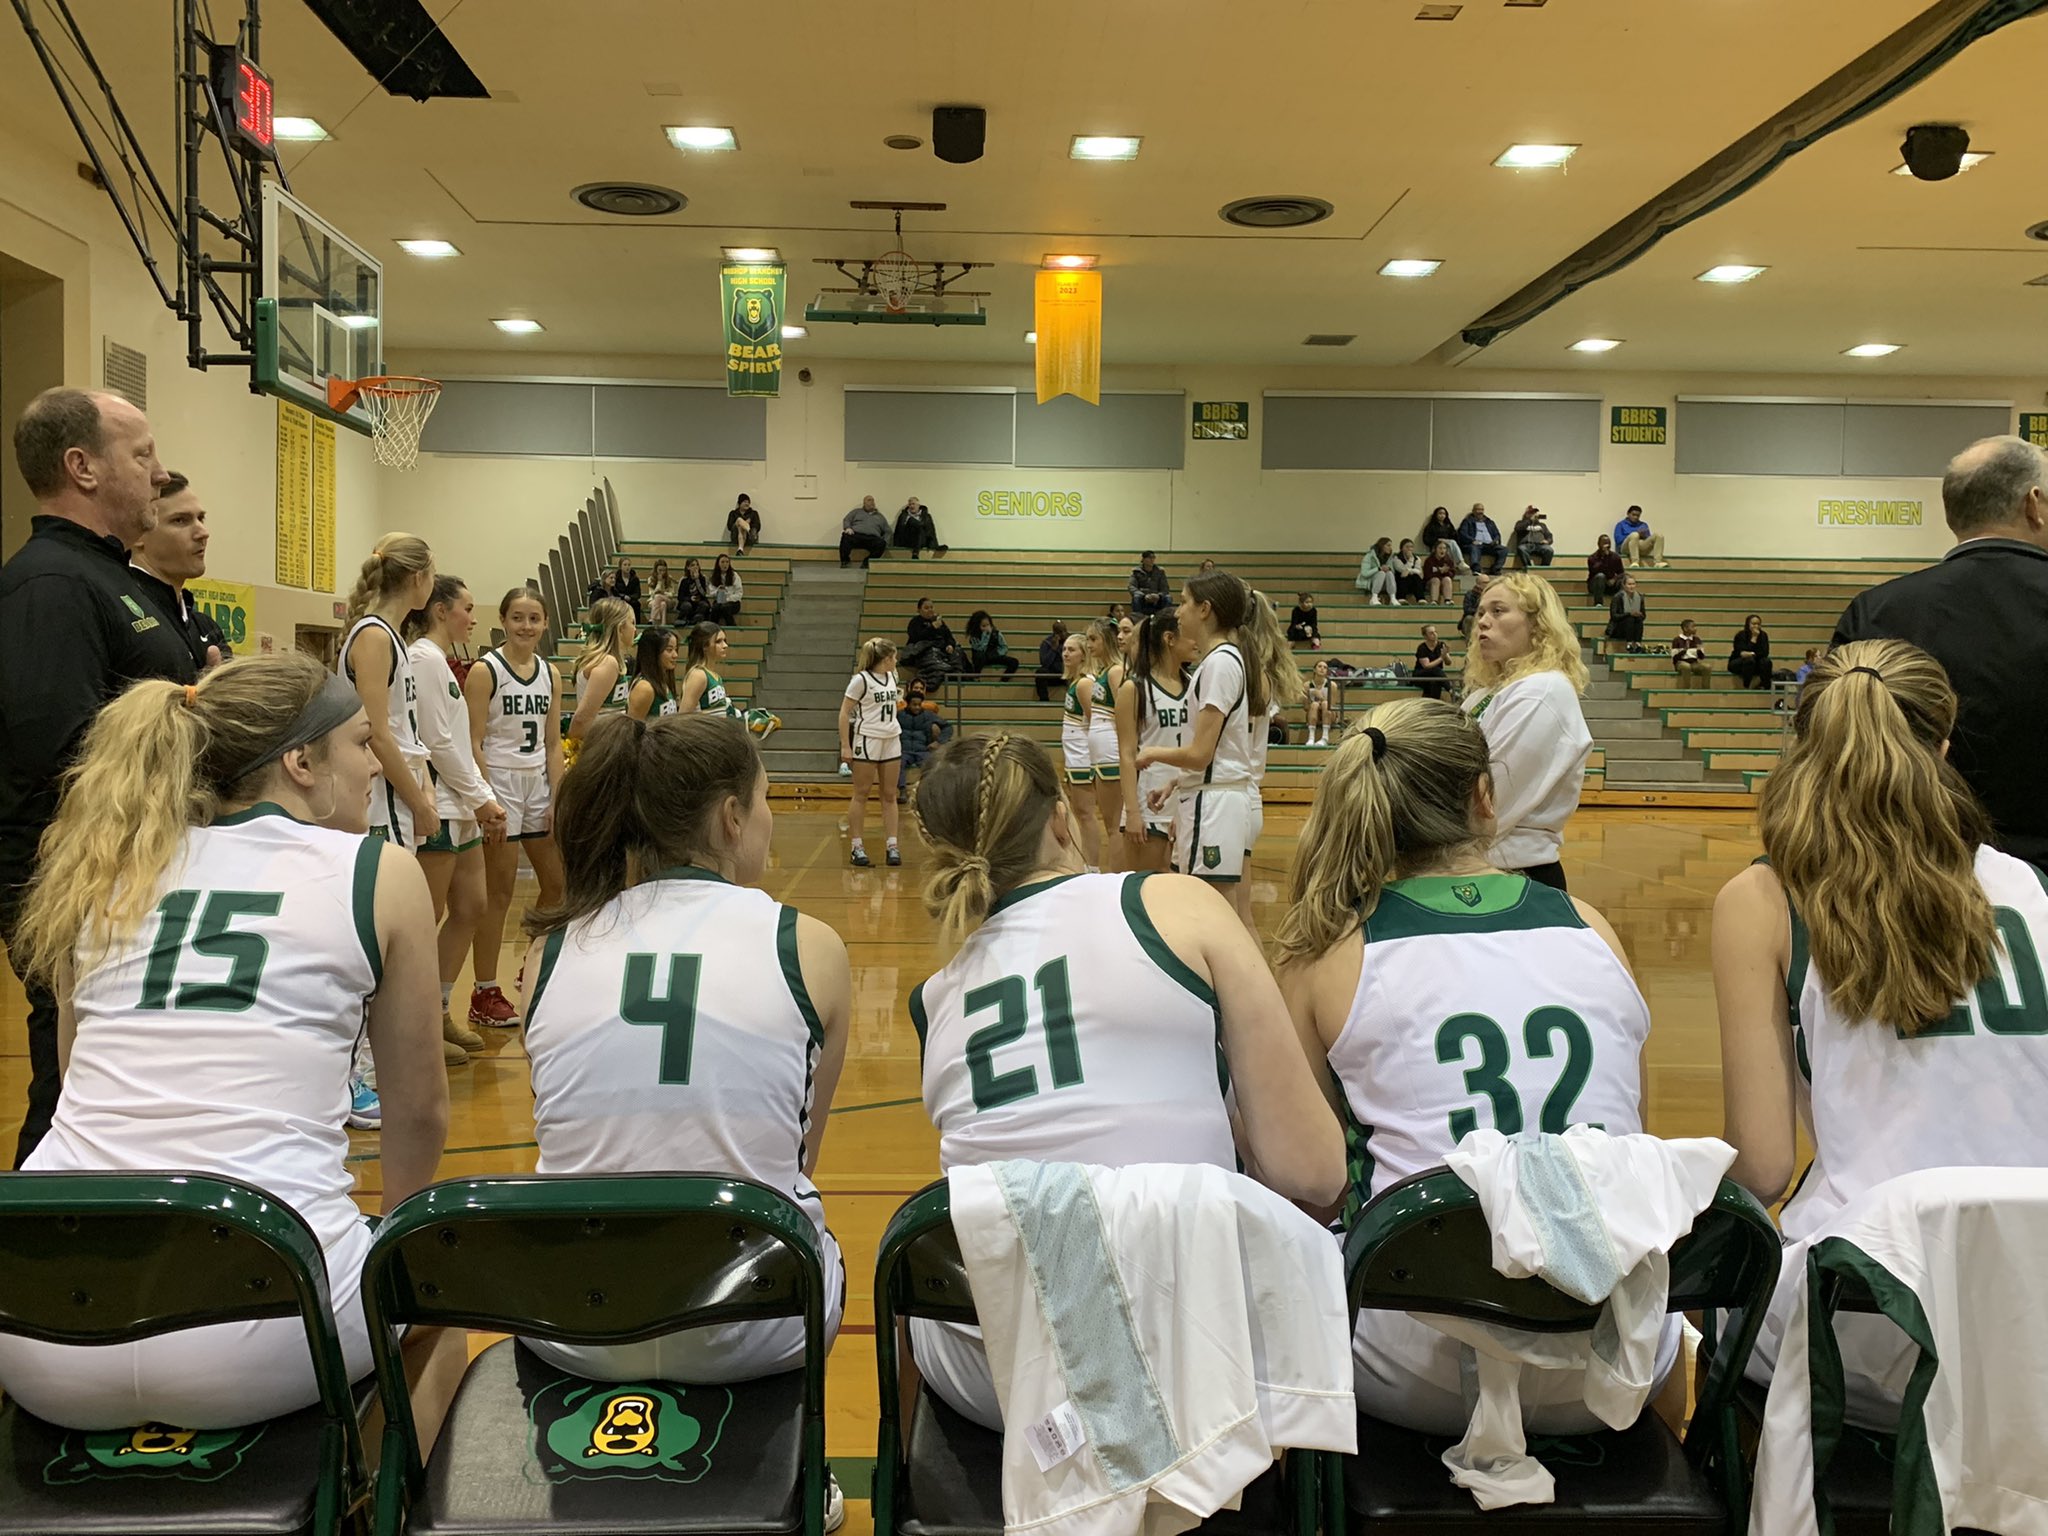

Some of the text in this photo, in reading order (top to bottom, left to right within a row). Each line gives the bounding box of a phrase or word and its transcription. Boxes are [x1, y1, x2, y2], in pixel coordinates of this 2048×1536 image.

[240, 64, 272, 144] 30
[728, 343, 781, 358] BEAR
[728, 358, 781, 373] SPIRIT
[1202, 403, 1239, 420] BBHS
[1620, 408, 1657, 425] BBHS
[1612, 426, 1665, 443] STUDENTS
[977, 490, 1083, 517] SENIORS
[1817, 500, 1923, 525] FRESHMEN
[502, 694, 550, 716] BEARS
[880, 704, 894, 722] 14
[519, 721, 538, 753] 3
[134, 889, 285, 1013] 15
[619, 953, 703, 1085] 4
[964, 954, 1084, 1114] 21
[1434, 1004, 1607, 1146] 32
